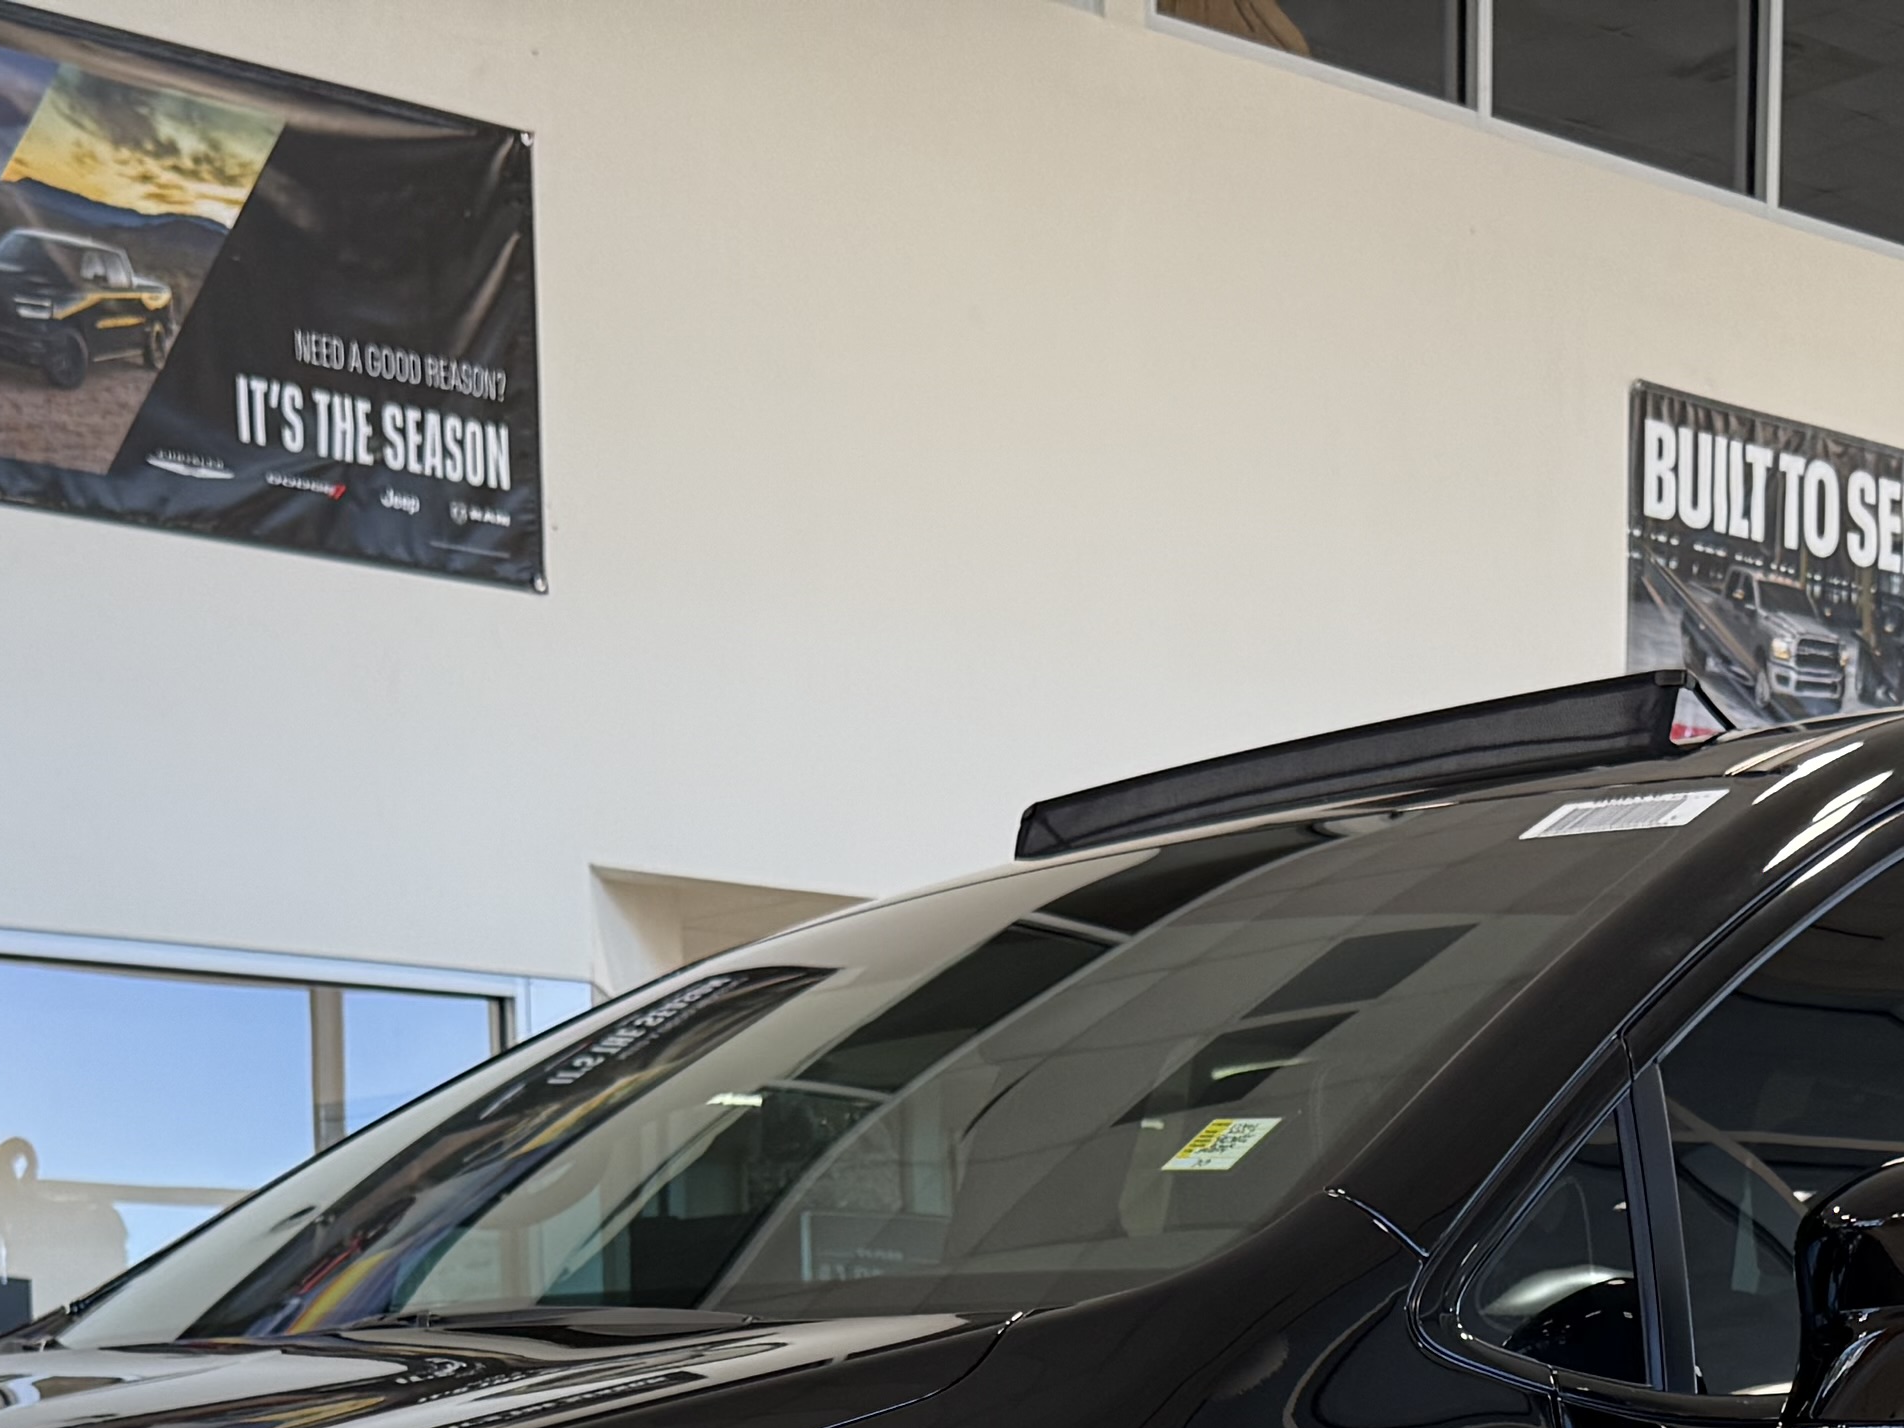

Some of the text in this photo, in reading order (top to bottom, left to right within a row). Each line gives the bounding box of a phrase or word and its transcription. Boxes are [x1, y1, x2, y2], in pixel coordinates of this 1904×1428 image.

[294, 329, 507, 403] NEED A GOOD REASON?
[235, 373, 511, 491] IT'S THE SEASON
[380, 484, 420, 515] Jeep
[1643, 418, 1774, 542] BUILT
[1779, 451, 1840, 559] TO
